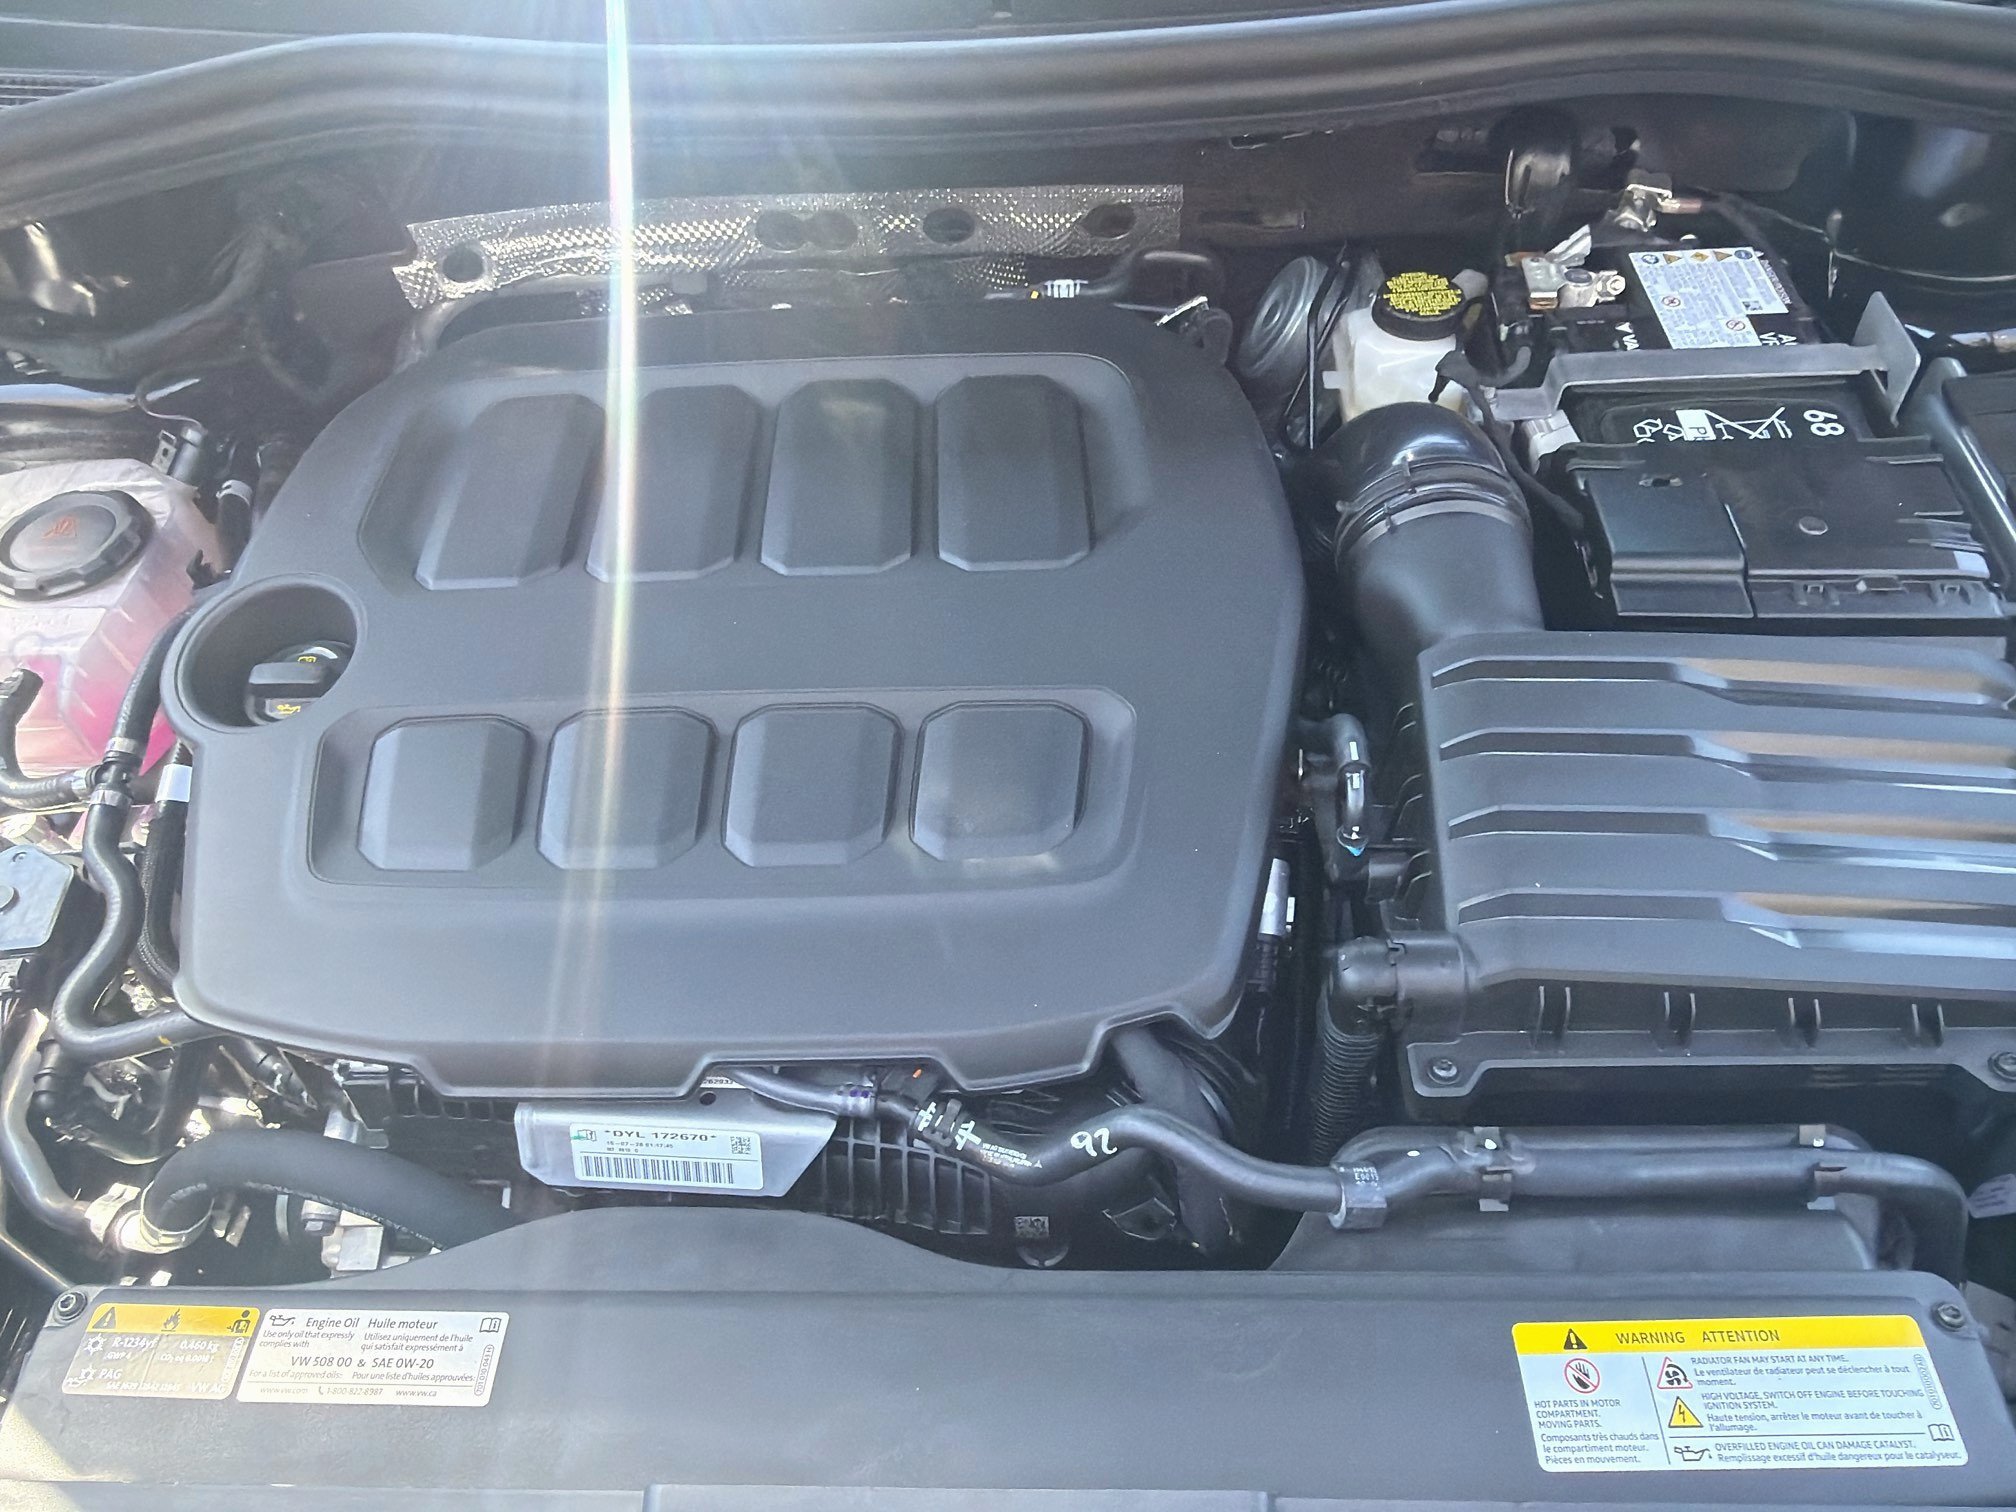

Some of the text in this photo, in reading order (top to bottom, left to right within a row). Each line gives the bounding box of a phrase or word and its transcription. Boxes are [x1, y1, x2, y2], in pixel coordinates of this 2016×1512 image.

[1803, 409, 1845, 436] 68
[1070, 1128, 1118, 1157] 92
[306, 1317, 438, 1330] Engine Oil Huile moteur
[263, 1330, 356, 1341] Use only oil that expressly
[364, 1332, 474, 1343] Utilisez uniquement de l'huile
[1616, 1330, 1781, 1344] WARNING ATTENTION
[260, 1340, 310, 1349] complies with
[361, 1343, 374, 1352] qui
[375, 1342, 404, 1351] satisfait
[405, 1343, 457, 1353] expressément
[291, 1356, 434, 1369] VW 508 00 & SAE 0W-20
[1691, 1356, 1732, 1365] RADIATOR
[1734, 1356, 1751, 1364] FAN
[1752, 1356, 1769, 1364] MAY
[1770, 1355, 1795, 1364] START
[1797, 1355, 1806, 1363] AT
[1808, 1355, 1824, 1363] ANY
[98, 1368, 123, 1380] PAG
[250, 1369, 262, 1378] For
[268, 1370, 282, 1378] list
[282, 1370, 290, 1378] of
[290, 1370, 325, 1381] approved
[1694, 1368, 1705, 1376] Le
[1706, 1368, 1752, 1376] ventilateur
[1753, 1368, 1764, 1376] de
[1766, 1366, 1804, 1376] radiateur
[1805, 1366, 1826, 1376] peut
[1826, 1366, 1836, 1374] se
[1838, 1365, 1883, 1374] déclencher
[1892, 1365, 1910, 1373] tout
[352, 1372, 369, 1380] Pour
[386, 1372, 400, 1380] liste
[402, 1372, 430, 1381] d'huiles
[1697, 1378, 1736, 1386] moment.
[1702, 1392, 1722, 1400] HIGH
[1763, 1391, 1796, 1400] SWITCH
[1797, 1390, 1813, 1399] OFF
[1815, 1390, 1846, 1398] ENGINE
[1848, 1390, 1879, 1398] BEFORE
[1880, 1389, 1925, 1398] TOUCHING
[1534, 1398, 1621, 1409] HOT PARTS IN MOTOR
[1704, 1401, 1778, 1410] IGNITION SYSTEM.
[1536, 1409, 1602, 1419] COMPARTMENT.
[1707, 1414, 1733, 1422] Haute
[1771, 1412, 1800, 1421] arrêter
[1801, 1412, 1810, 1420] le
[1811, 1412, 1842, 1420] moteur
[1845, 1412, 1868, 1420] avant
[1870, 1411, 1880, 1420] de
[1883, 1410, 1915, 1419] toucher
[1538, 1419, 1602, 1429] MOVING PARTS.
[1541, 1432, 1660, 1444] Composants très chauds dans
[1543, 1444, 1649, 1455] le compartiment moteur.
[1715, 1440, 1916, 1452] OVERFILLED ENGINE OIL CAN DAMAGE CATALYST.
[1545, 1455, 1641, 1464] Pièces en mouvement.
[1718, 1454, 1771, 1464] Remplissage
[1773, 1453, 1806, 1462] excessif
[1808, 1452, 1836, 1460] d'huile
[1838, 1452, 1882, 1462] dangereux
[1884, 1452, 1904, 1462] pour
[1915, 1450, 1962, 1461] catalyseur.
